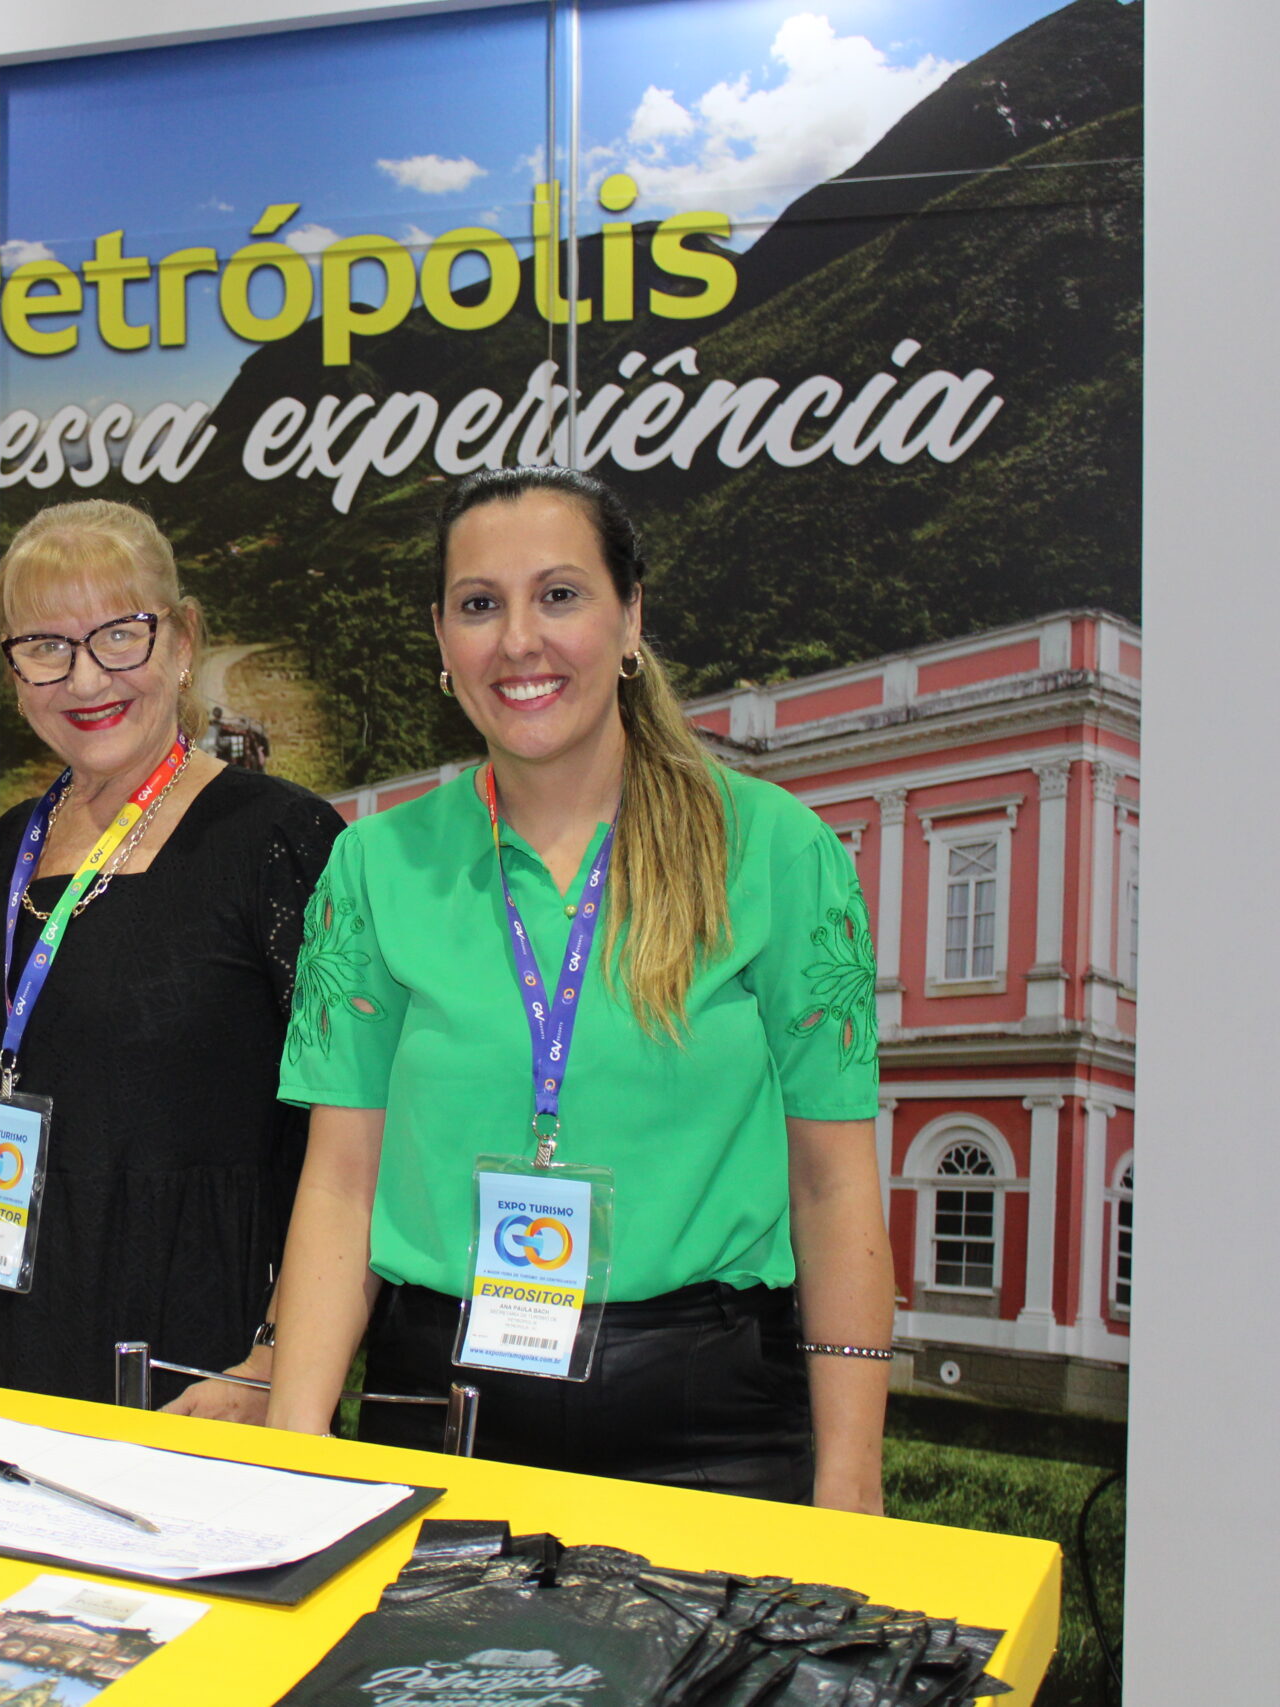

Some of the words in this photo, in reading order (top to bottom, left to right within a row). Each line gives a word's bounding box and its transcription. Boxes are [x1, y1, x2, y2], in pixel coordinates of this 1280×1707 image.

[242, 338, 1004, 514] experiência
[590, 869, 601, 887] GAV
[46, 921, 59, 941] GAV
[569, 951, 581, 972] GAV
[15, 996, 27, 1016] GAV
[532, 1002, 545, 1021] GAV
[550, 1039, 563, 1062] GAV
[497, 1200, 527, 1212] EXPO
[530, 1203, 574, 1217] TURISMO
[480, 1283, 576, 1308] EXPOSITOR
[499, 1303, 512, 1311] ANA
[513, 1305, 533, 1313] PAULA
